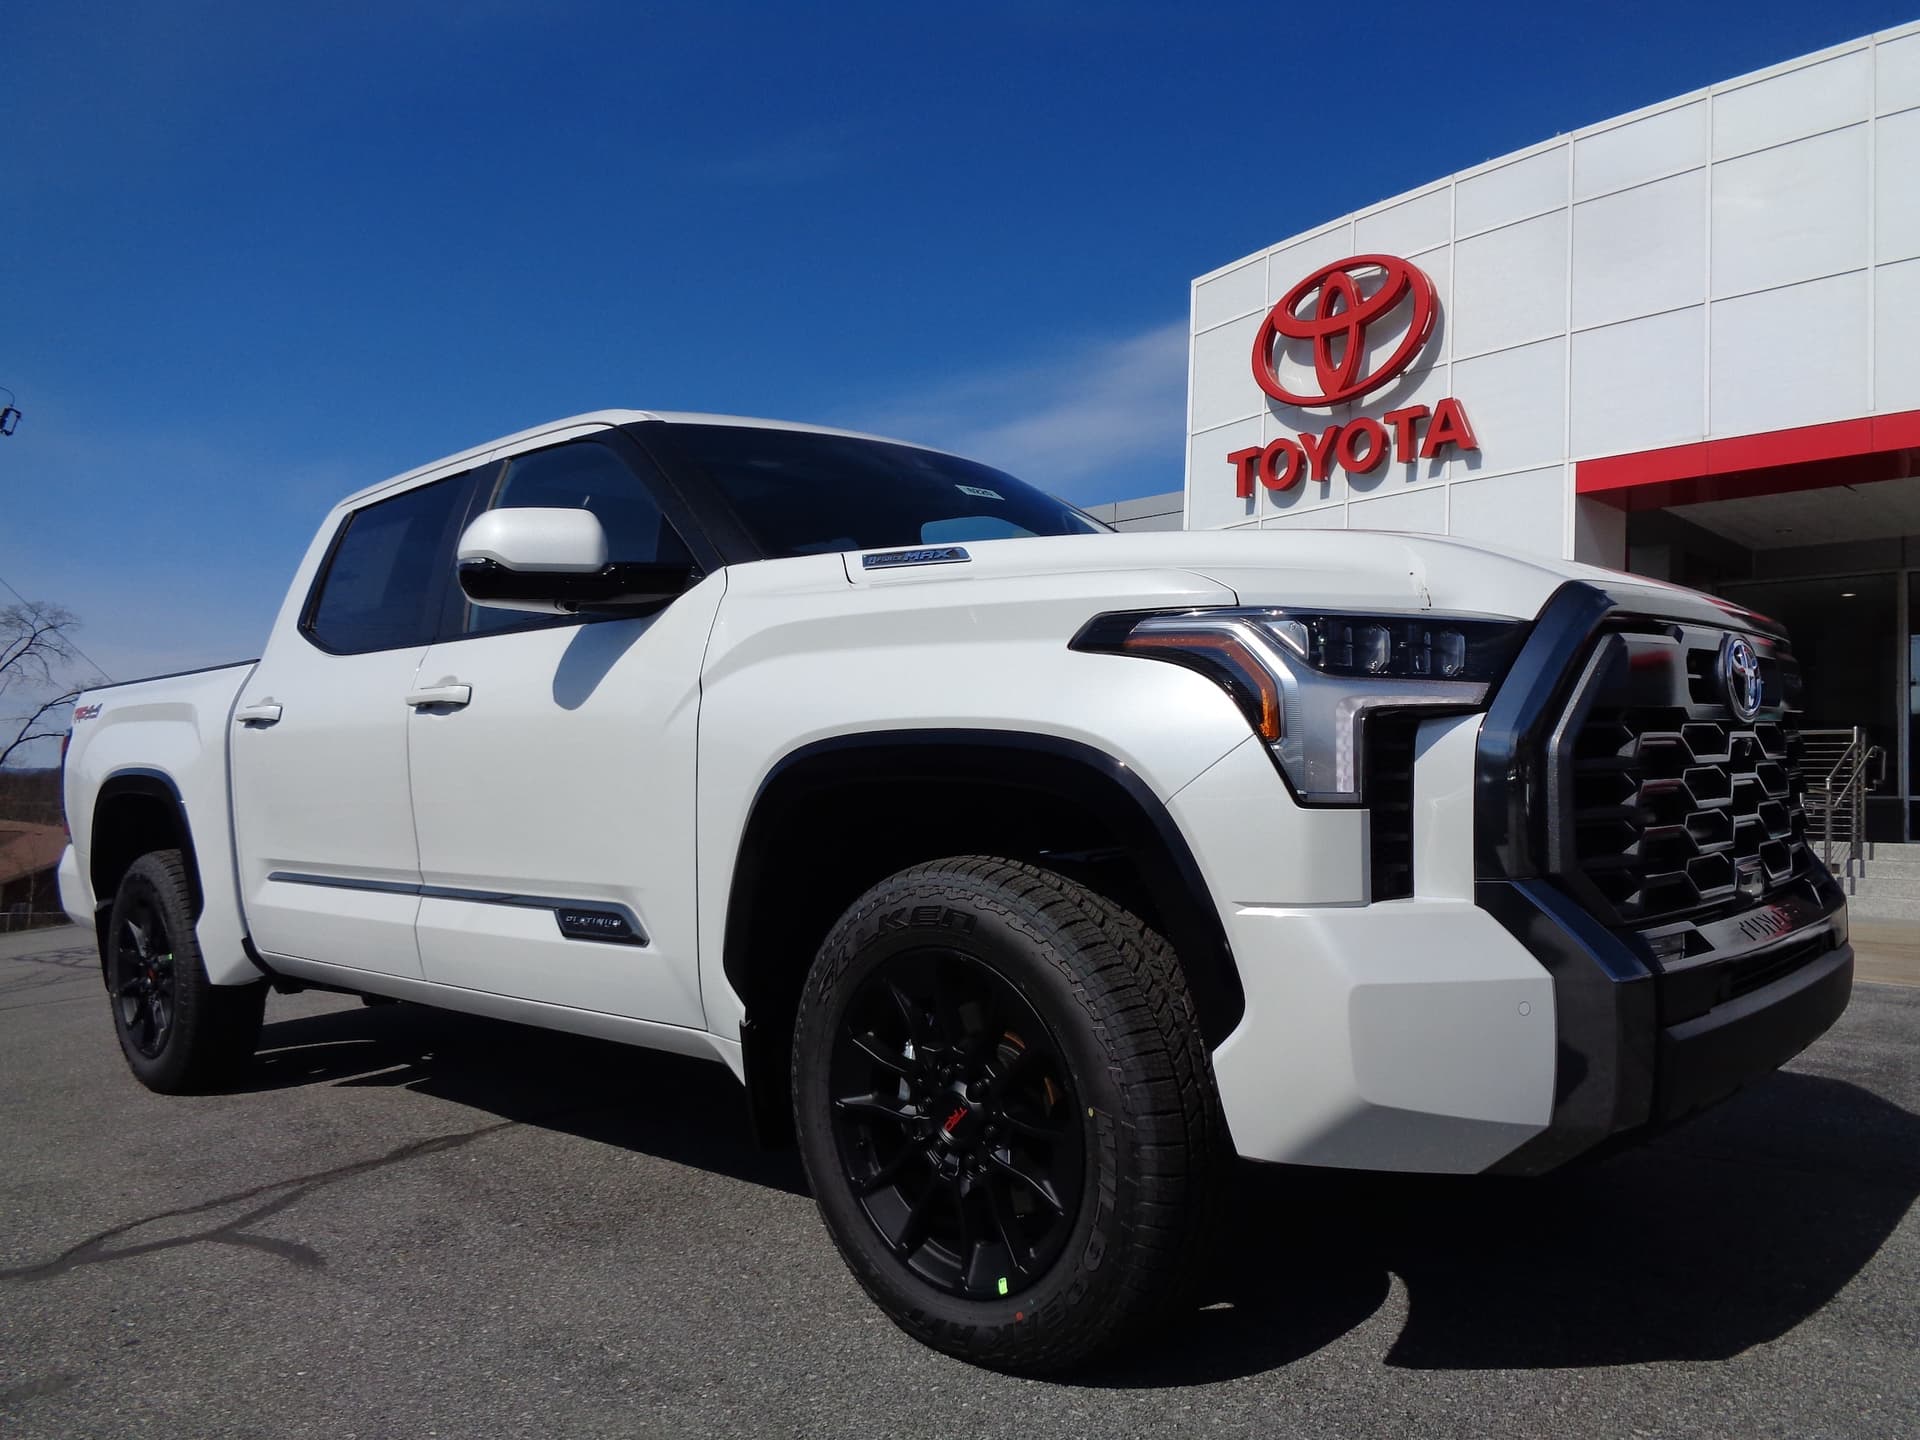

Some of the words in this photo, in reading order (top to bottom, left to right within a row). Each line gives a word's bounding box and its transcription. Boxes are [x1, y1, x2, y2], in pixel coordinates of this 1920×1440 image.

[1227, 397, 1480, 498] TOYOTA
[903, 550, 951, 562] MAX
[566, 916, 622, 928] PLATINUM
[944, 1107, 968, 1131] TRD
